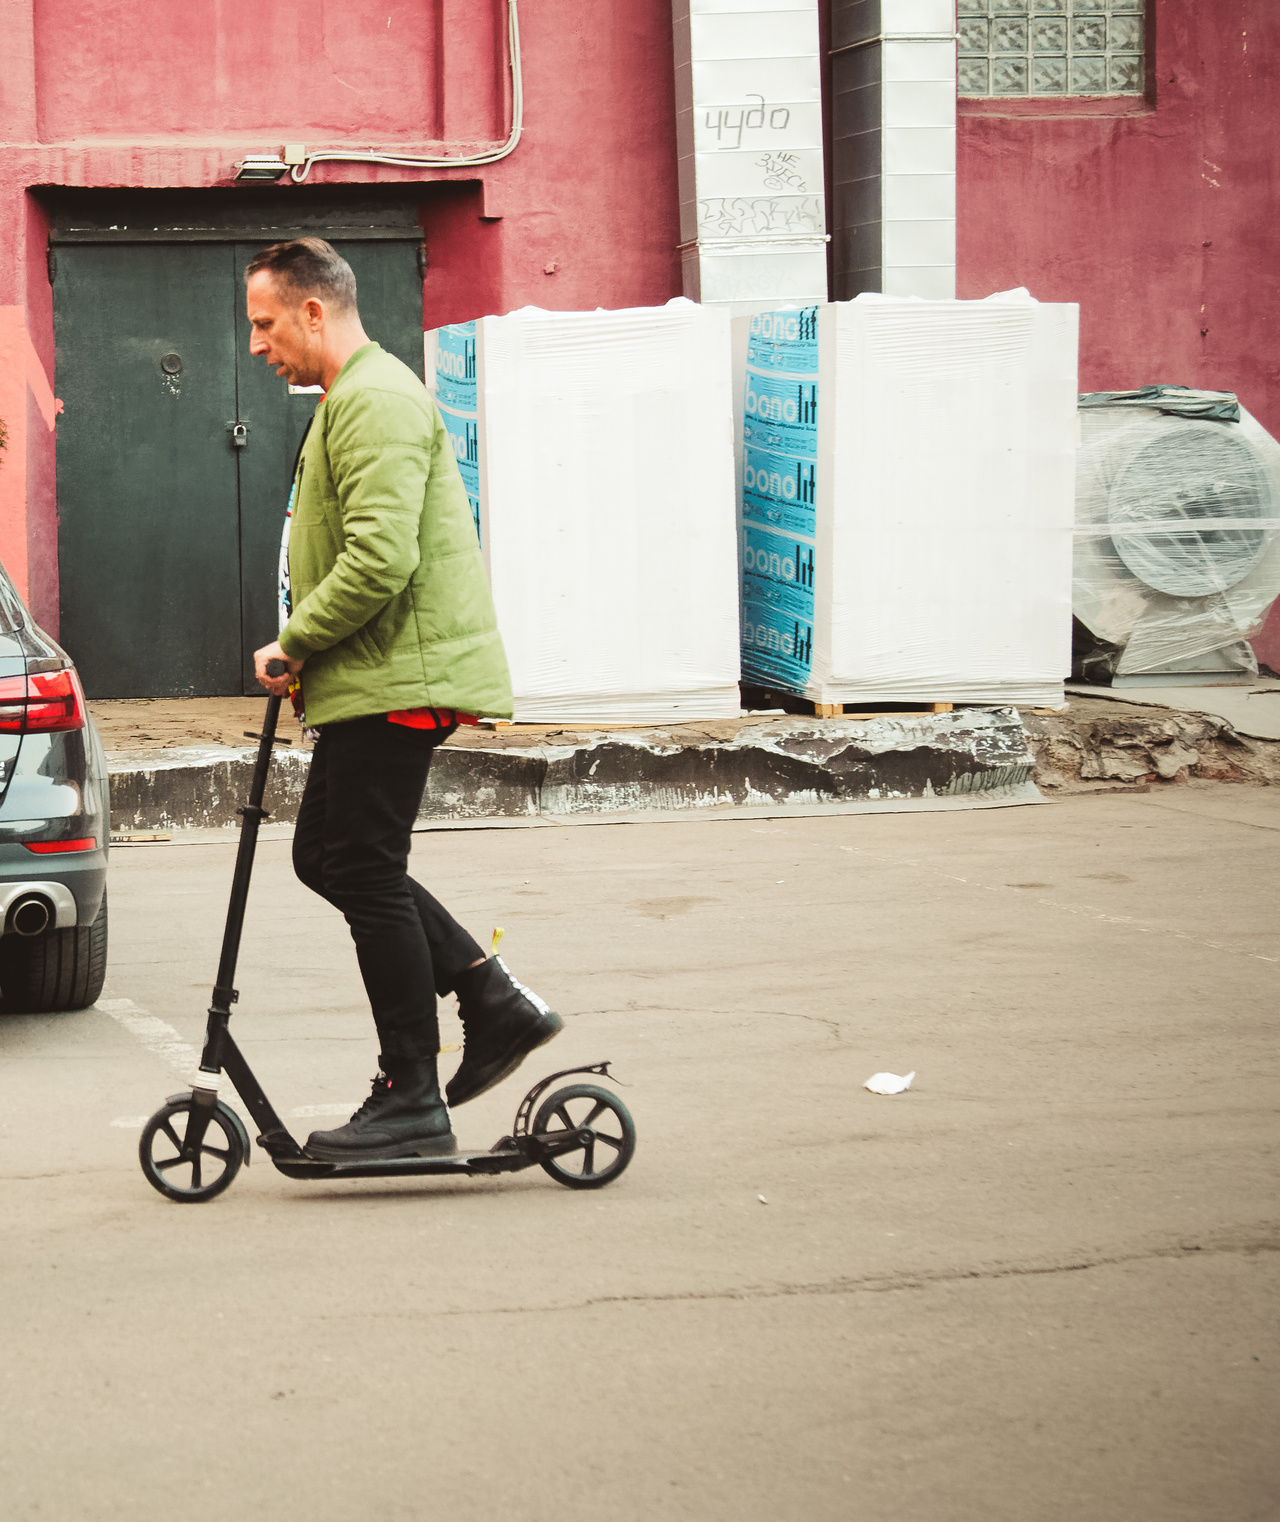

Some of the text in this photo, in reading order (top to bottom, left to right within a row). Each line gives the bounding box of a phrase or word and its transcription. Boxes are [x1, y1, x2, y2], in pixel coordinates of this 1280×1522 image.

[745, 374, 817, 425] bonolit
[743, 448, 816, 504] bonolit
[743, 529, 814, 588] bonolit
[742, 606, 812, 665] bonolit
